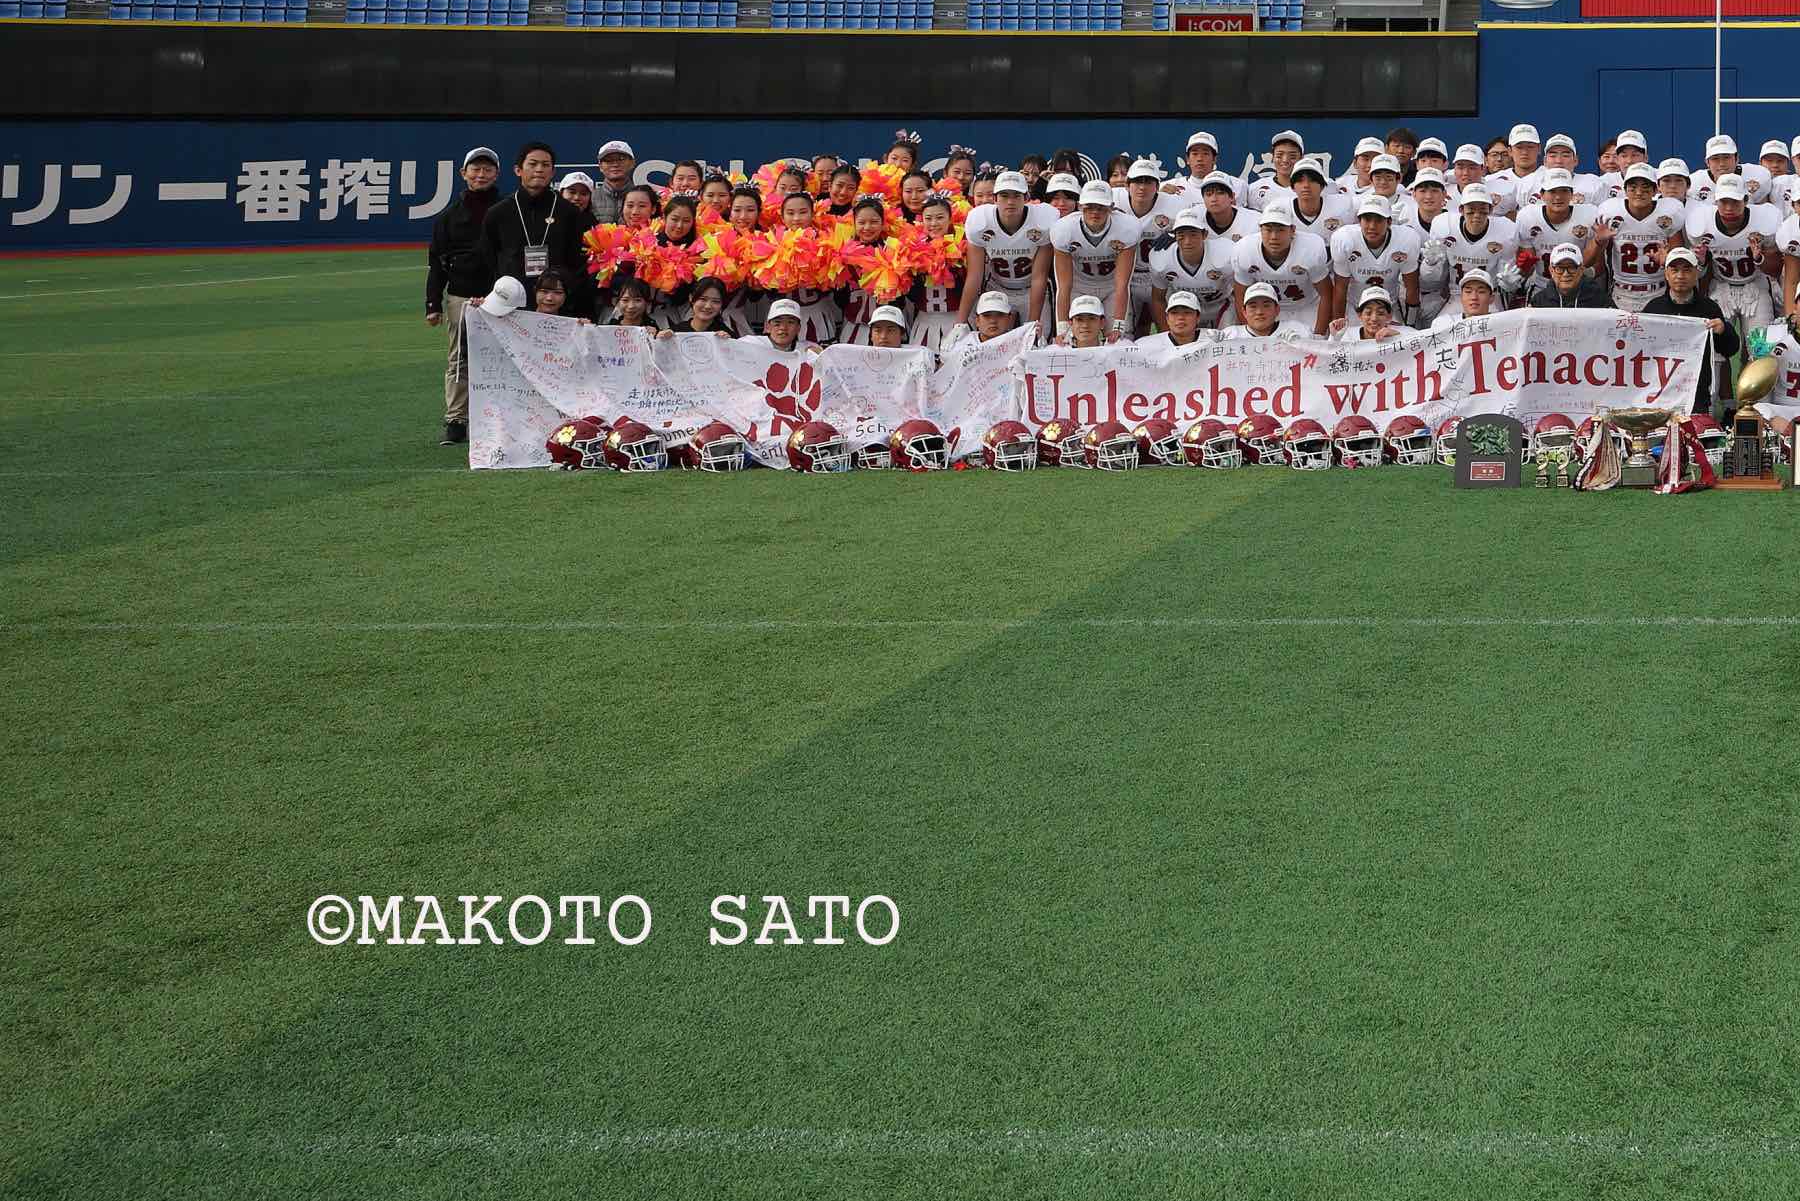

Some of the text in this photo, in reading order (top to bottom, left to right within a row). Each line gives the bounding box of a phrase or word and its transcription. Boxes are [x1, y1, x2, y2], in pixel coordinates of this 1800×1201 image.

[991, 257, 1034, 279] 22
[1025, 363, 1305, 426] Unleashed
[1324, 350, 1444, 416] with
[1457, 336, 1685, 404] Tenacity
